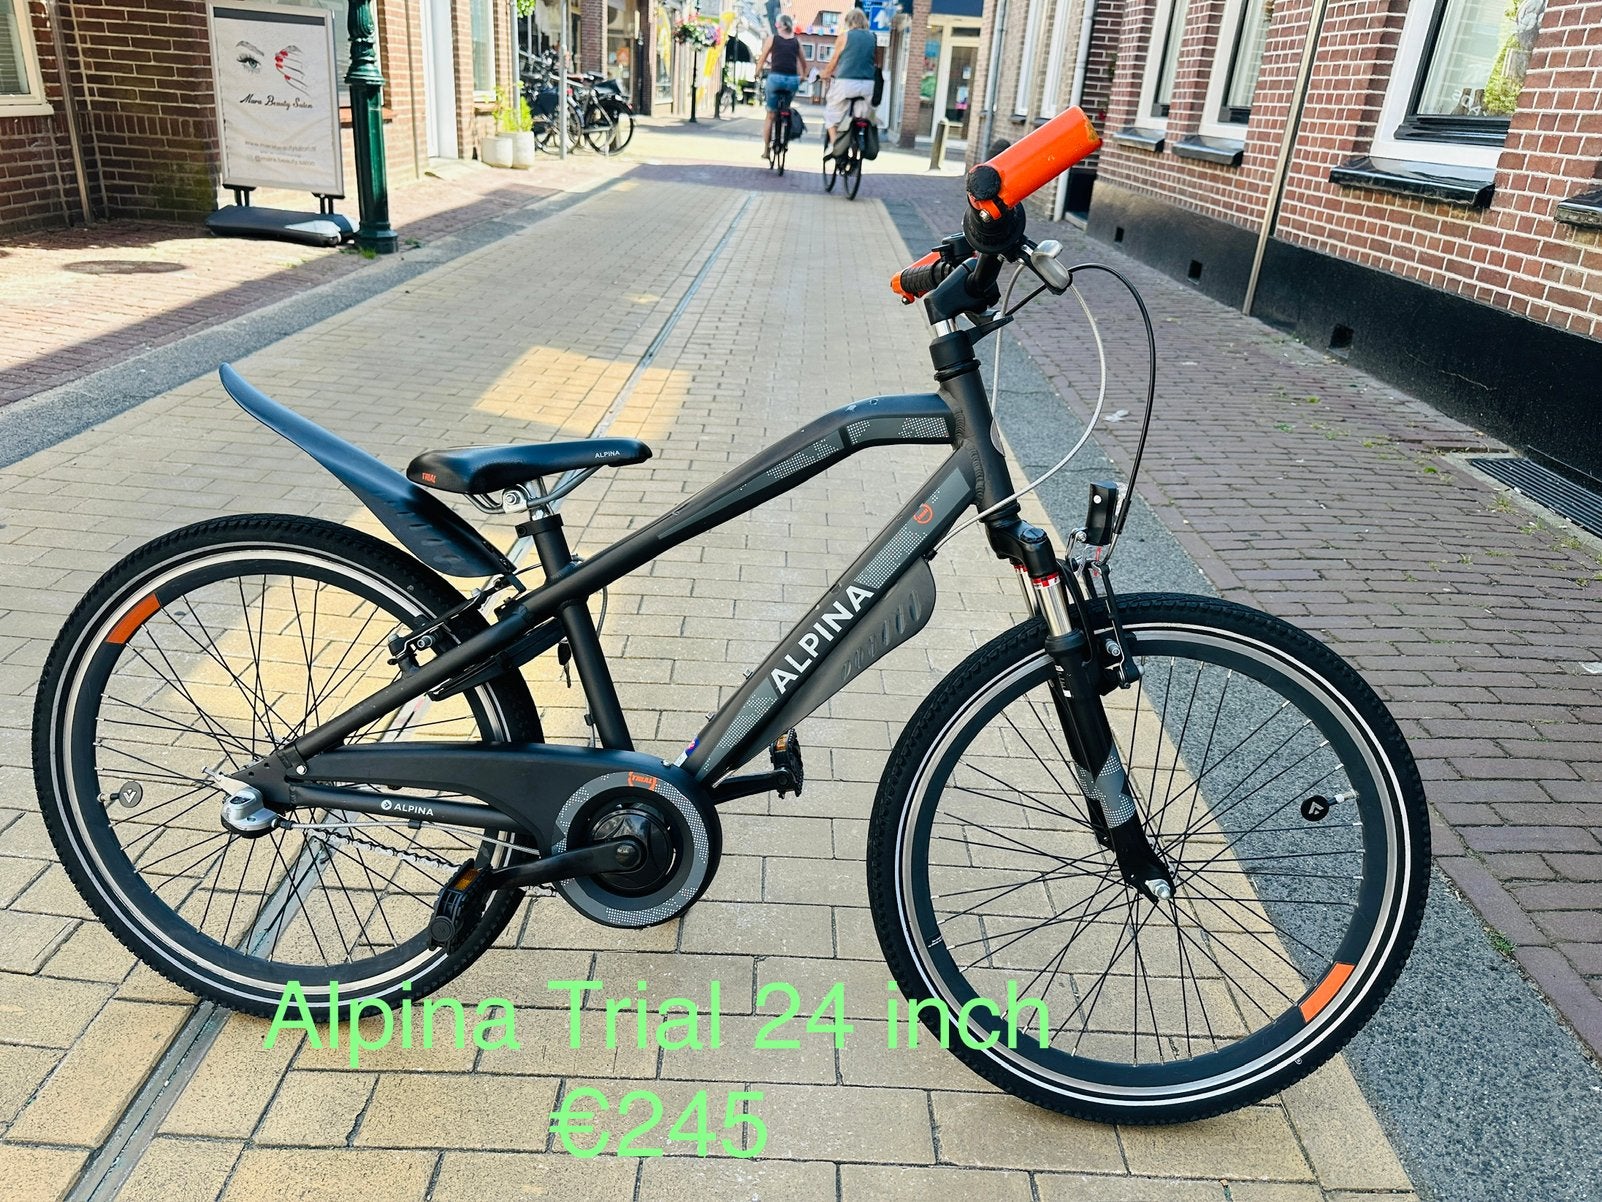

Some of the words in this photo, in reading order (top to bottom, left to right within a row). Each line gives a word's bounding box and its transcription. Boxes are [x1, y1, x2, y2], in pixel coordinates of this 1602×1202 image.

[240, 94, 262, 105] Mara
[265, 95, 290, 111] Beauty
[293, 97, 313, 109] Salon
[594, 450, 620, 459] ALPINA
[421, 472, 437, 484] TRIAL
[770, 585, 875, 695] ALPINA
[394, 803, 434, 816] ALPINA
